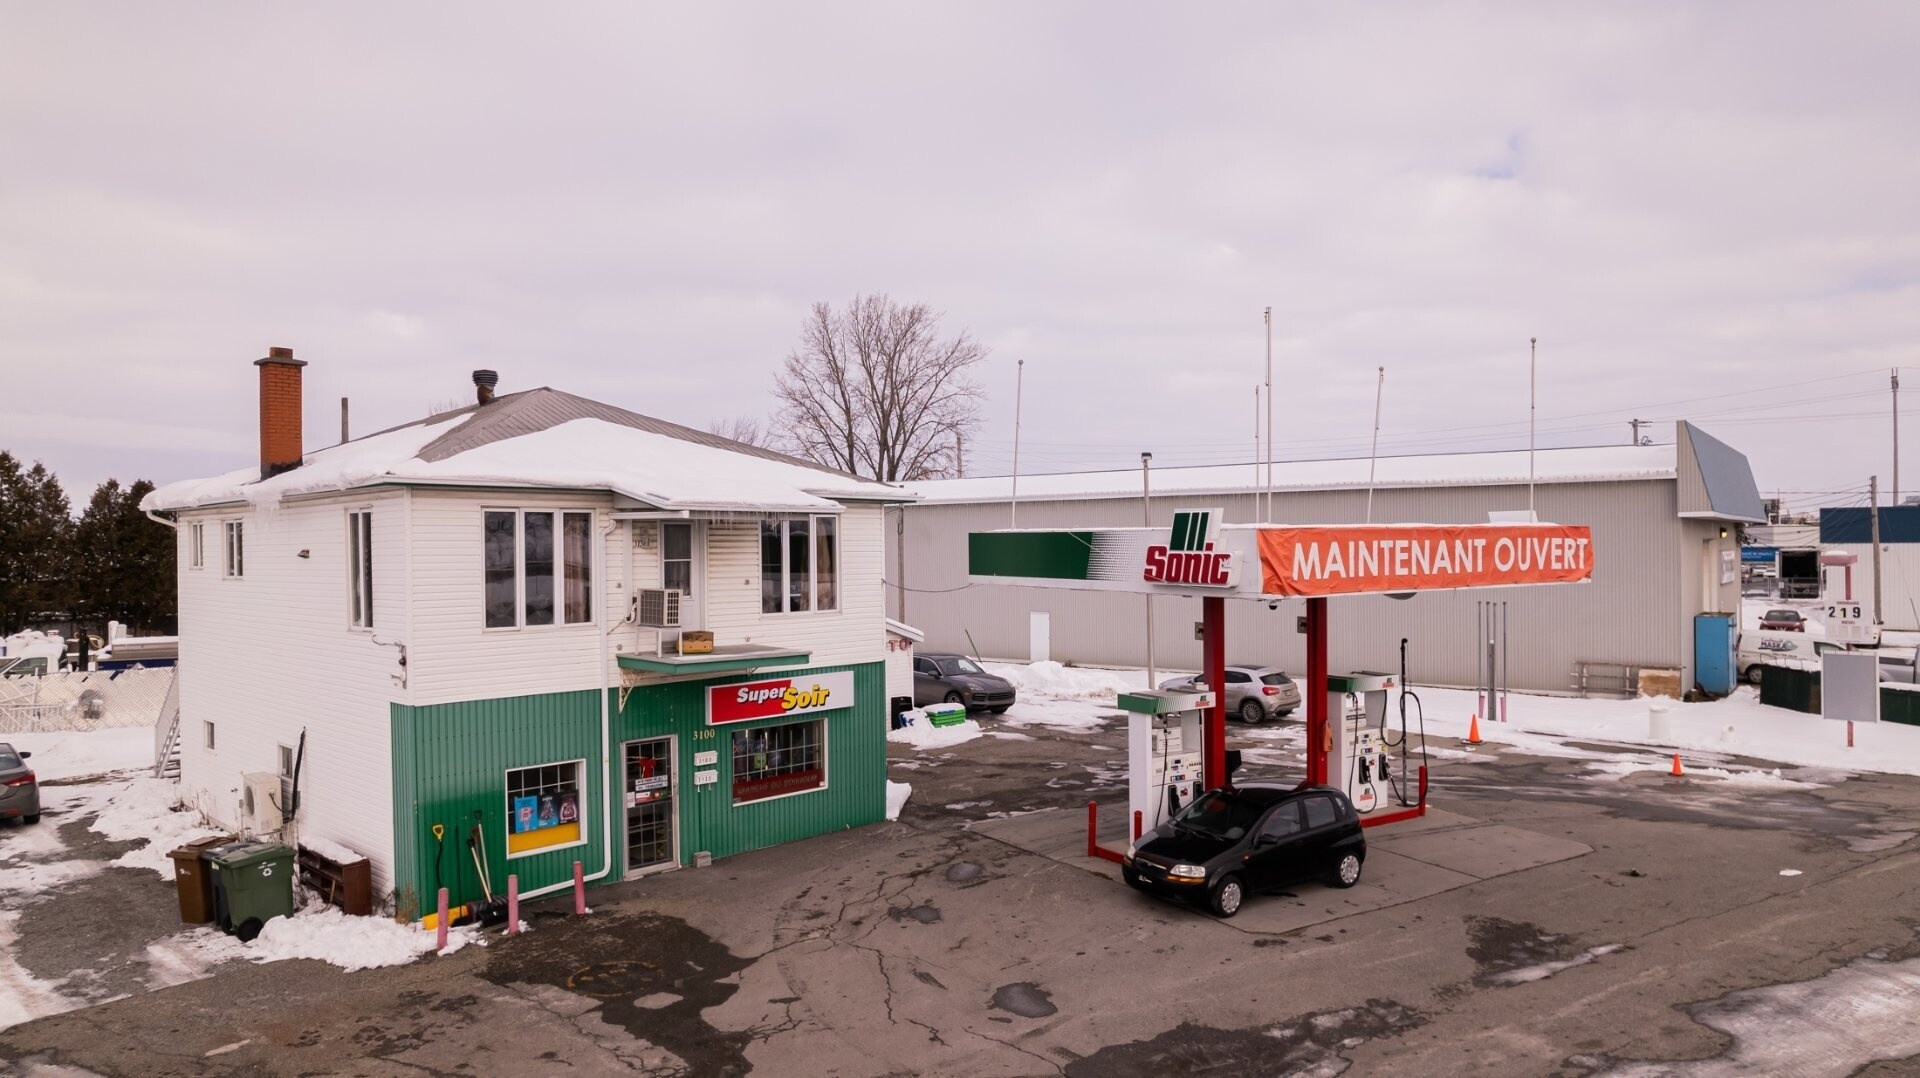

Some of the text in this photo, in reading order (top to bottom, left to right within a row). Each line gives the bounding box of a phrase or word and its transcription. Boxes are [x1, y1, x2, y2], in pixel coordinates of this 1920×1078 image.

[1143, 542, 1231, 585] Sonic
[1292, 537, 1589, 582] MAINTENANT OUVERT
[1828, 606, 1861, 619] 219
[736, 684, 830, 710] Super Soir
[692, 729, 715, 741] 3100
